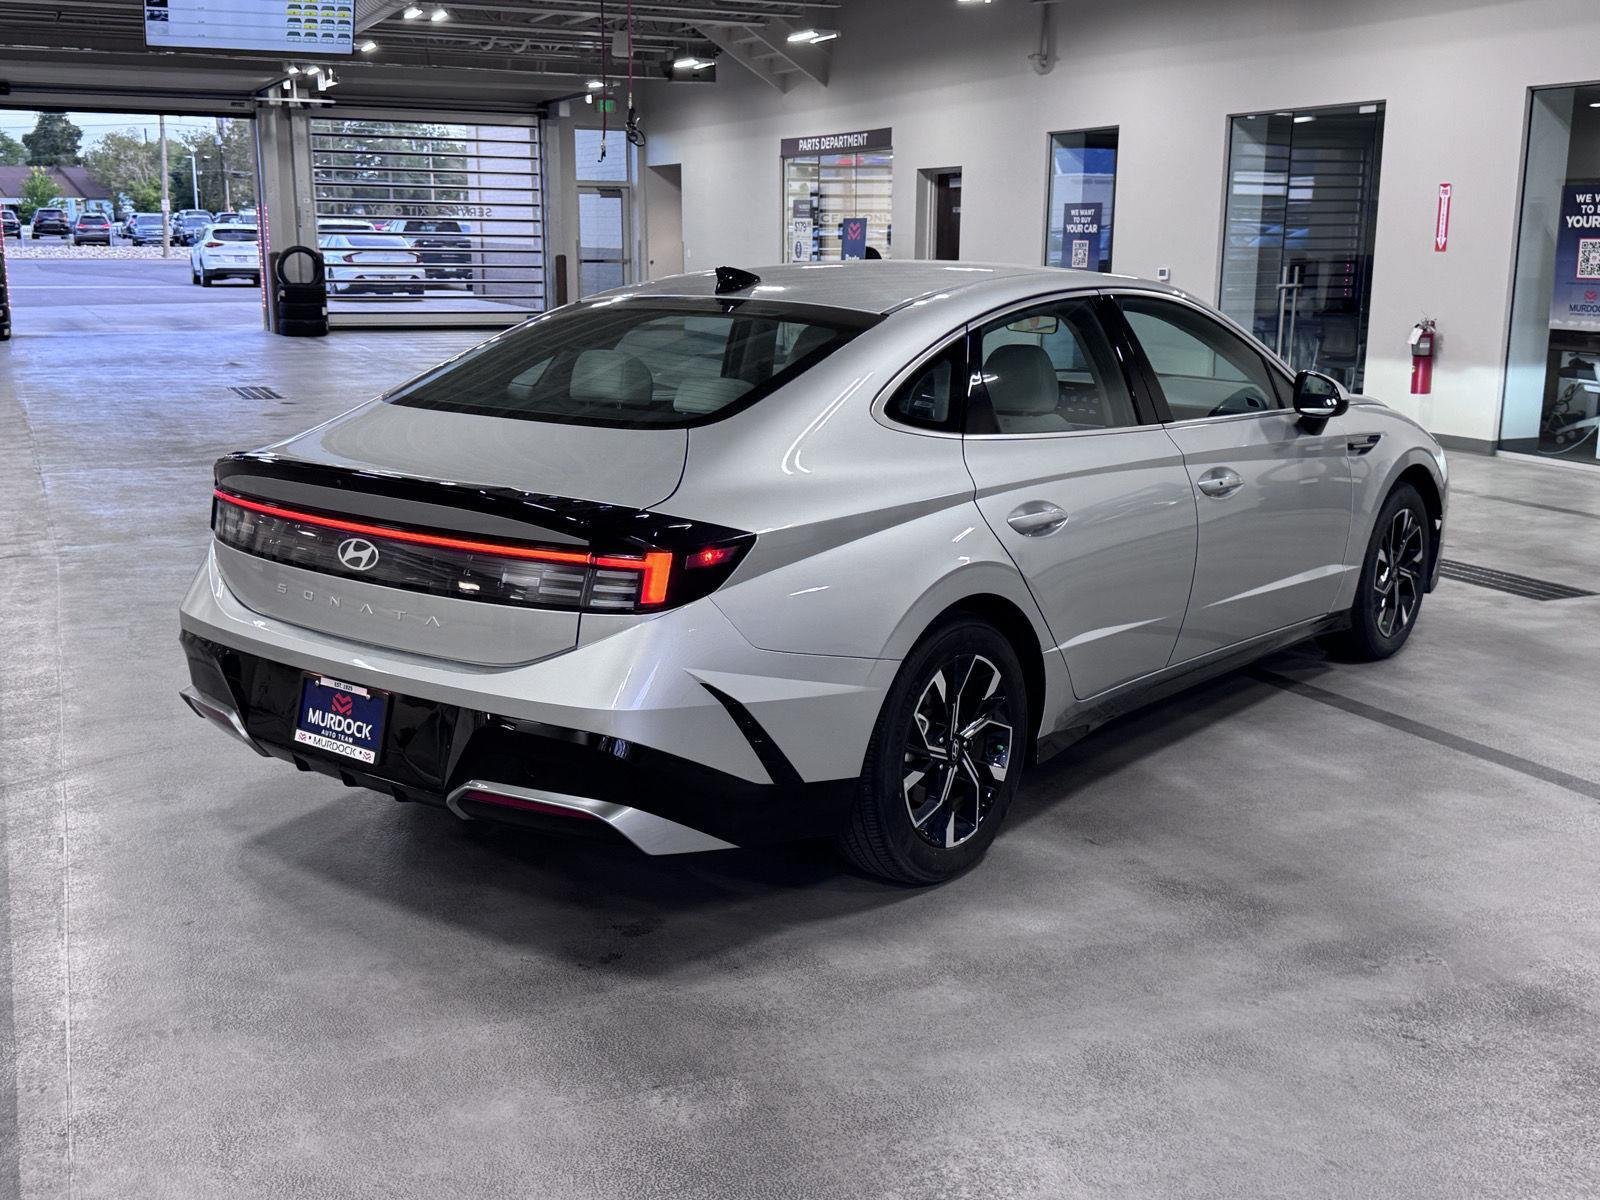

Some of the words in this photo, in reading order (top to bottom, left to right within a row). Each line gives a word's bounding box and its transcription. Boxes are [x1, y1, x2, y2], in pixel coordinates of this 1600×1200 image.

[798, 138, 820, 152] PARTS
[820, 133, 868, 149] DEPARTMENT
[1575, 193, 1593, 203] WE
[1580, 204, 1595, 214] TO
[1066, 223, 1083, 233] YOUR
[1083, 224, 1098, 233] CAR
[1565, 215, 1600, 228] YOUR
[276, 583, 441, 628] SONATA
[307, 707, 373, 739] MURDOCK
[321, 729, 336, 738] AUTO
[338, 733, 354, 743] TEAM
[313, 737, 357, 757] MURDOCK
